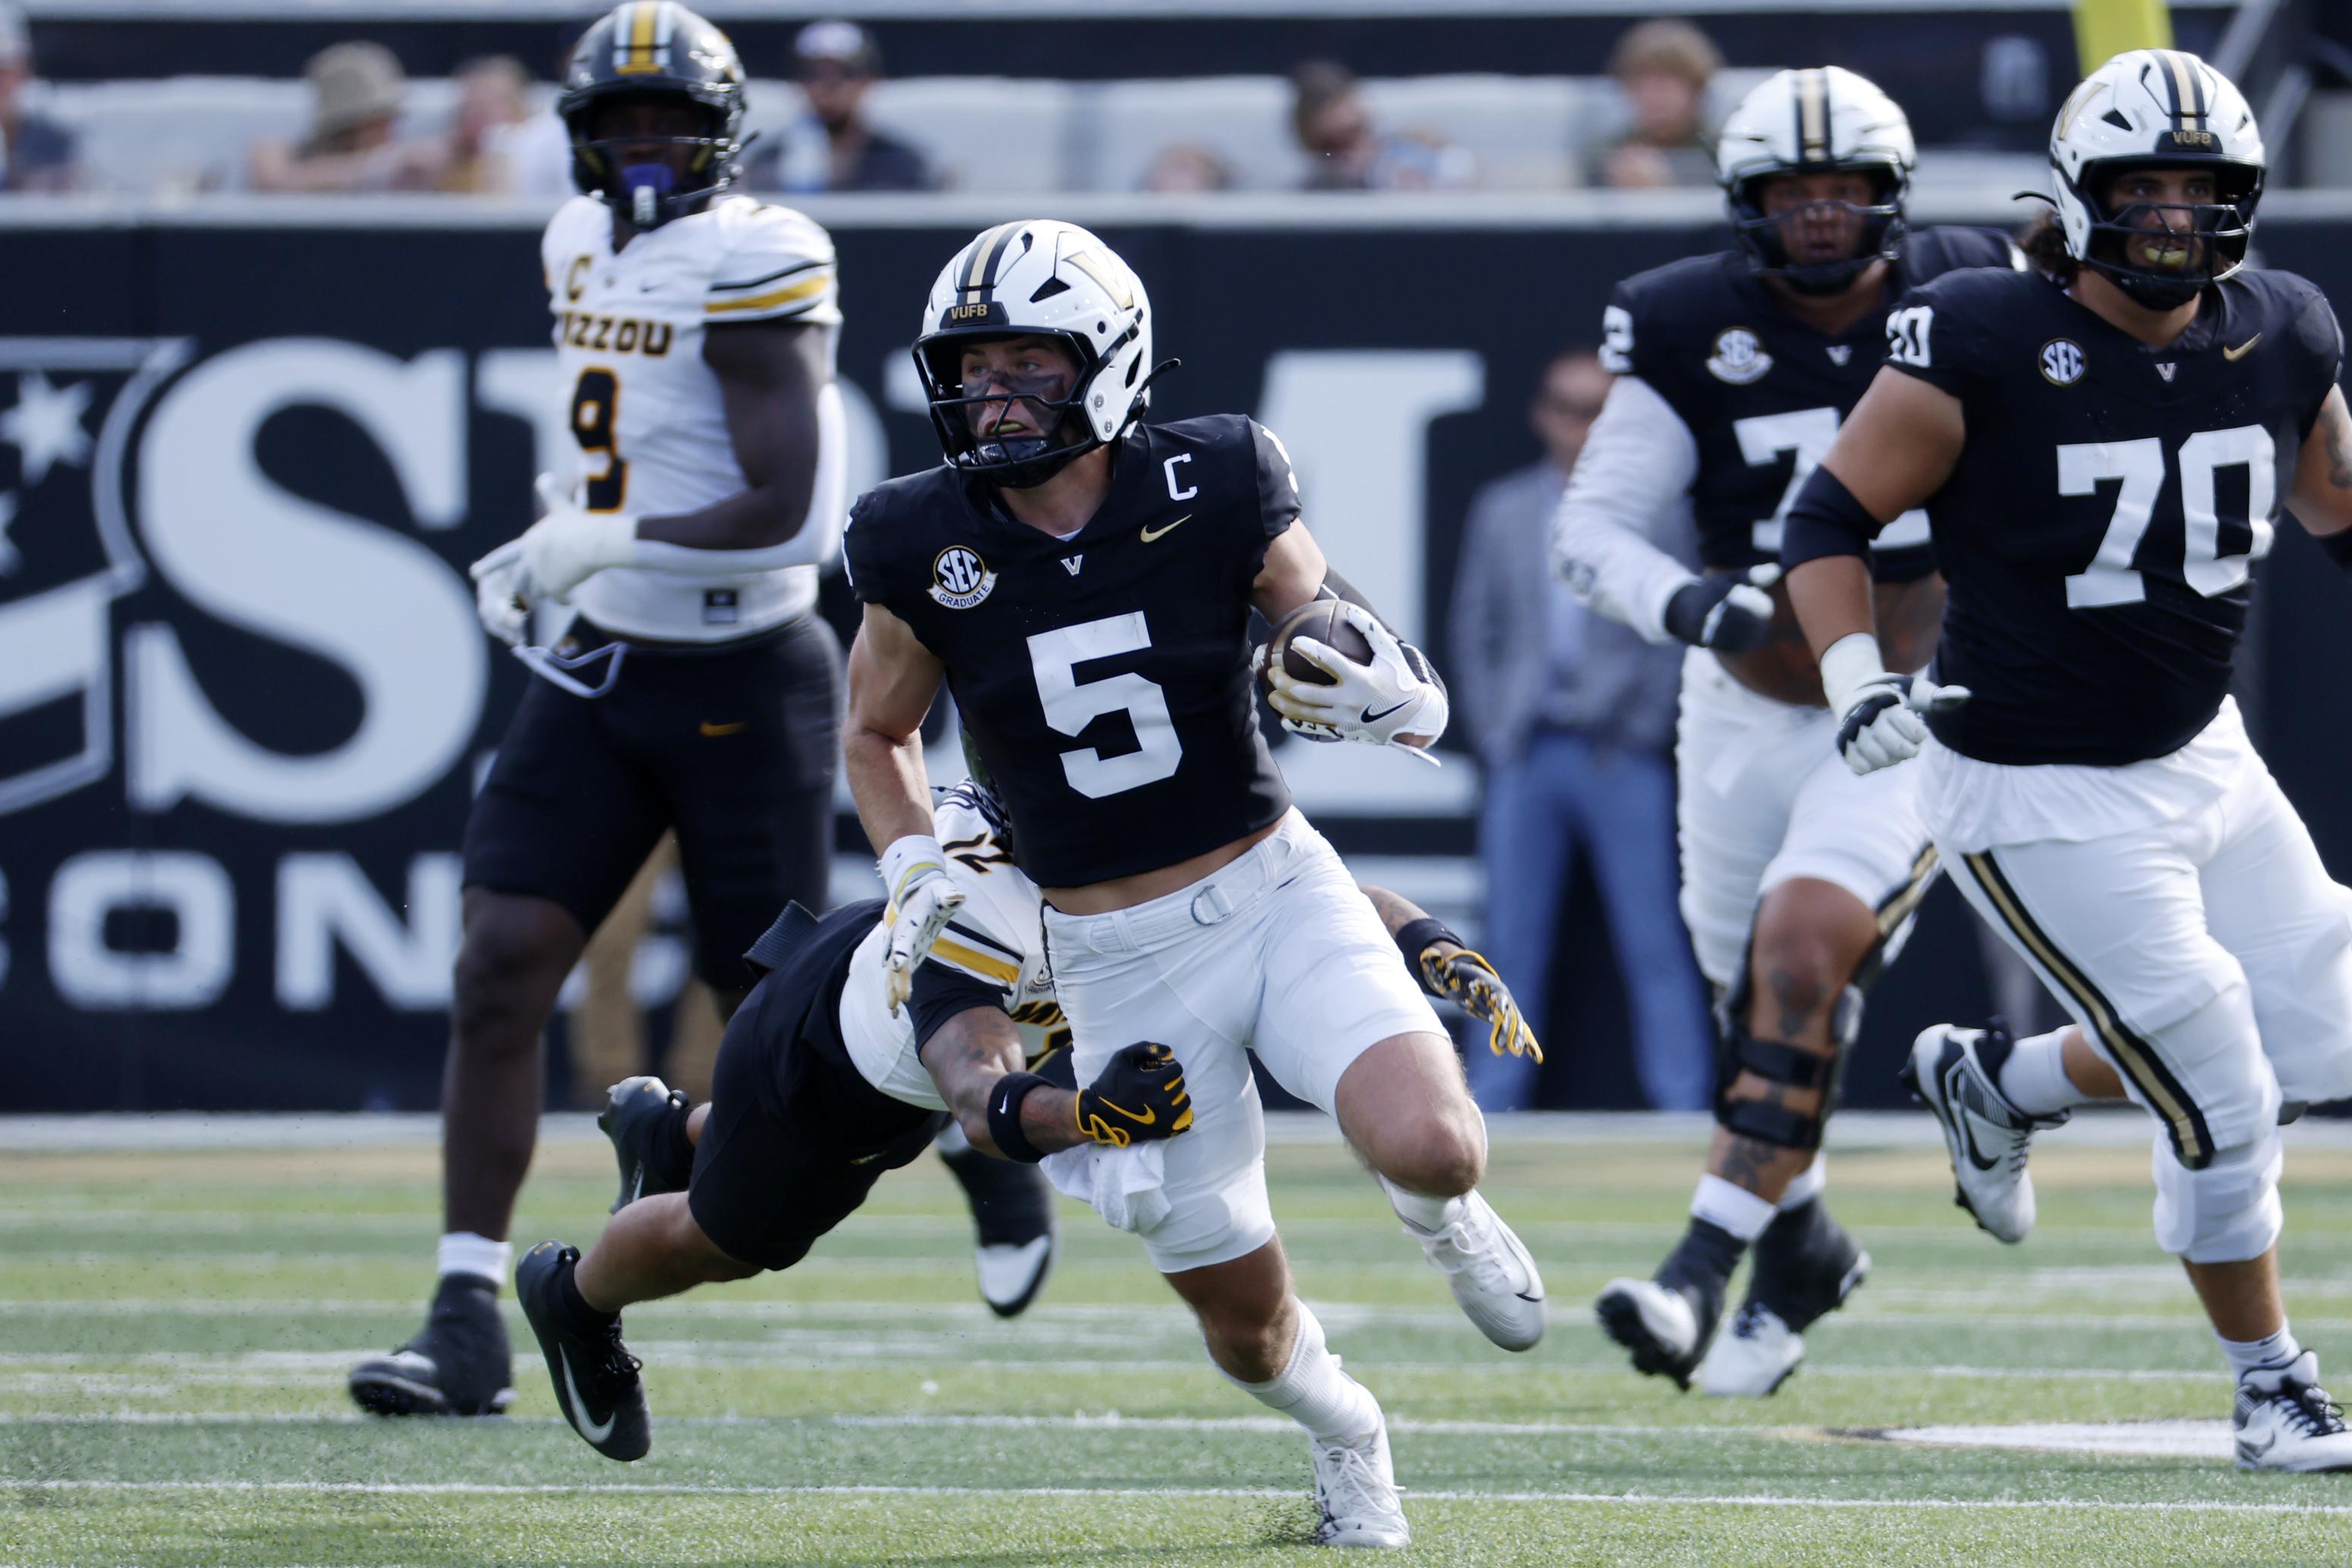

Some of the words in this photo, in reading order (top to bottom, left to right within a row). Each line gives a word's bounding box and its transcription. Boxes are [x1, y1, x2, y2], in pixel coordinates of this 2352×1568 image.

[2172, 131, 2211, 145] VUFB
[567, 254, 594, 303] C
[951, 304, 987, 320] VUFB
[2042, 341, 2083, 383] SEC
[2155, 362, 2177, 383] V
[571, 367, 628, 513] 9
[1163, 453, 1198, 501] C
[2056, 423, 2275, 609] 70
[937, 549, 981, 593] SEC
[1060, 554, 1083, 576] V
[938, 584, 990, 607] GRADUATE
[1026, 610, 1182, 799] 5
